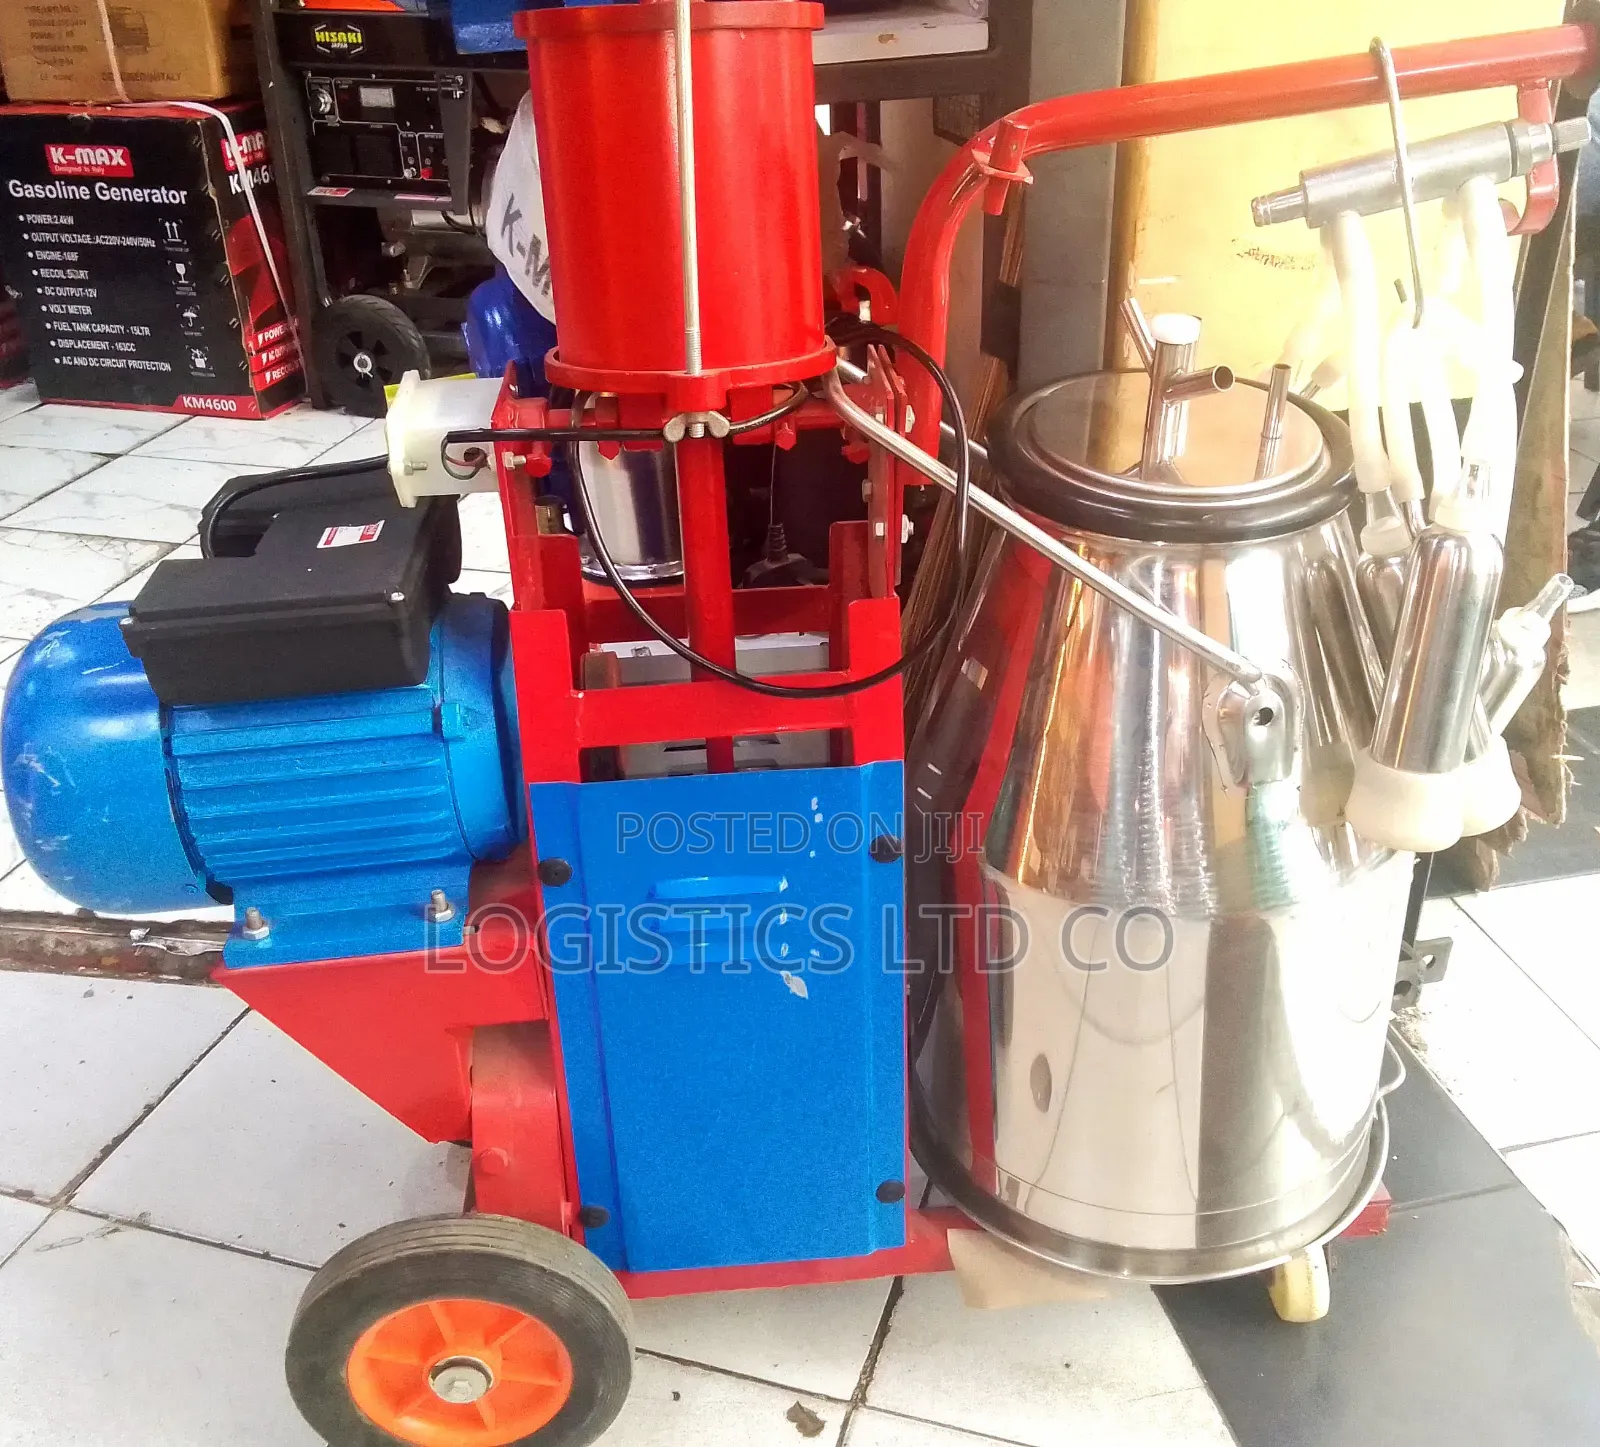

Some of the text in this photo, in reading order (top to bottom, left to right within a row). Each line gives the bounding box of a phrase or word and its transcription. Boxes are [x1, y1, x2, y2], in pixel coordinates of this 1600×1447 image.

[315, 31, 362, 44] HISAKI
[50, 146, 127, 167] K-MAX
[8, 179, 188, 205] Gasoline Generator
[31, 232, 60, 243] OUTPUT
[45, 286, 56, 296] DC
[48, 304, 93, 316] VOLT METER
[53, 321, 72, 332] FUEL
[71, 322, 92, 333] TANK
[91, 324, 125, 335] CAPACITY
[57, 339, 110, 351] DISPLACEMENT
[62, 356, 172, 372] AC AND DC CIRCUIT PROTECTION
[182, 396, 237, 412] KM4600
